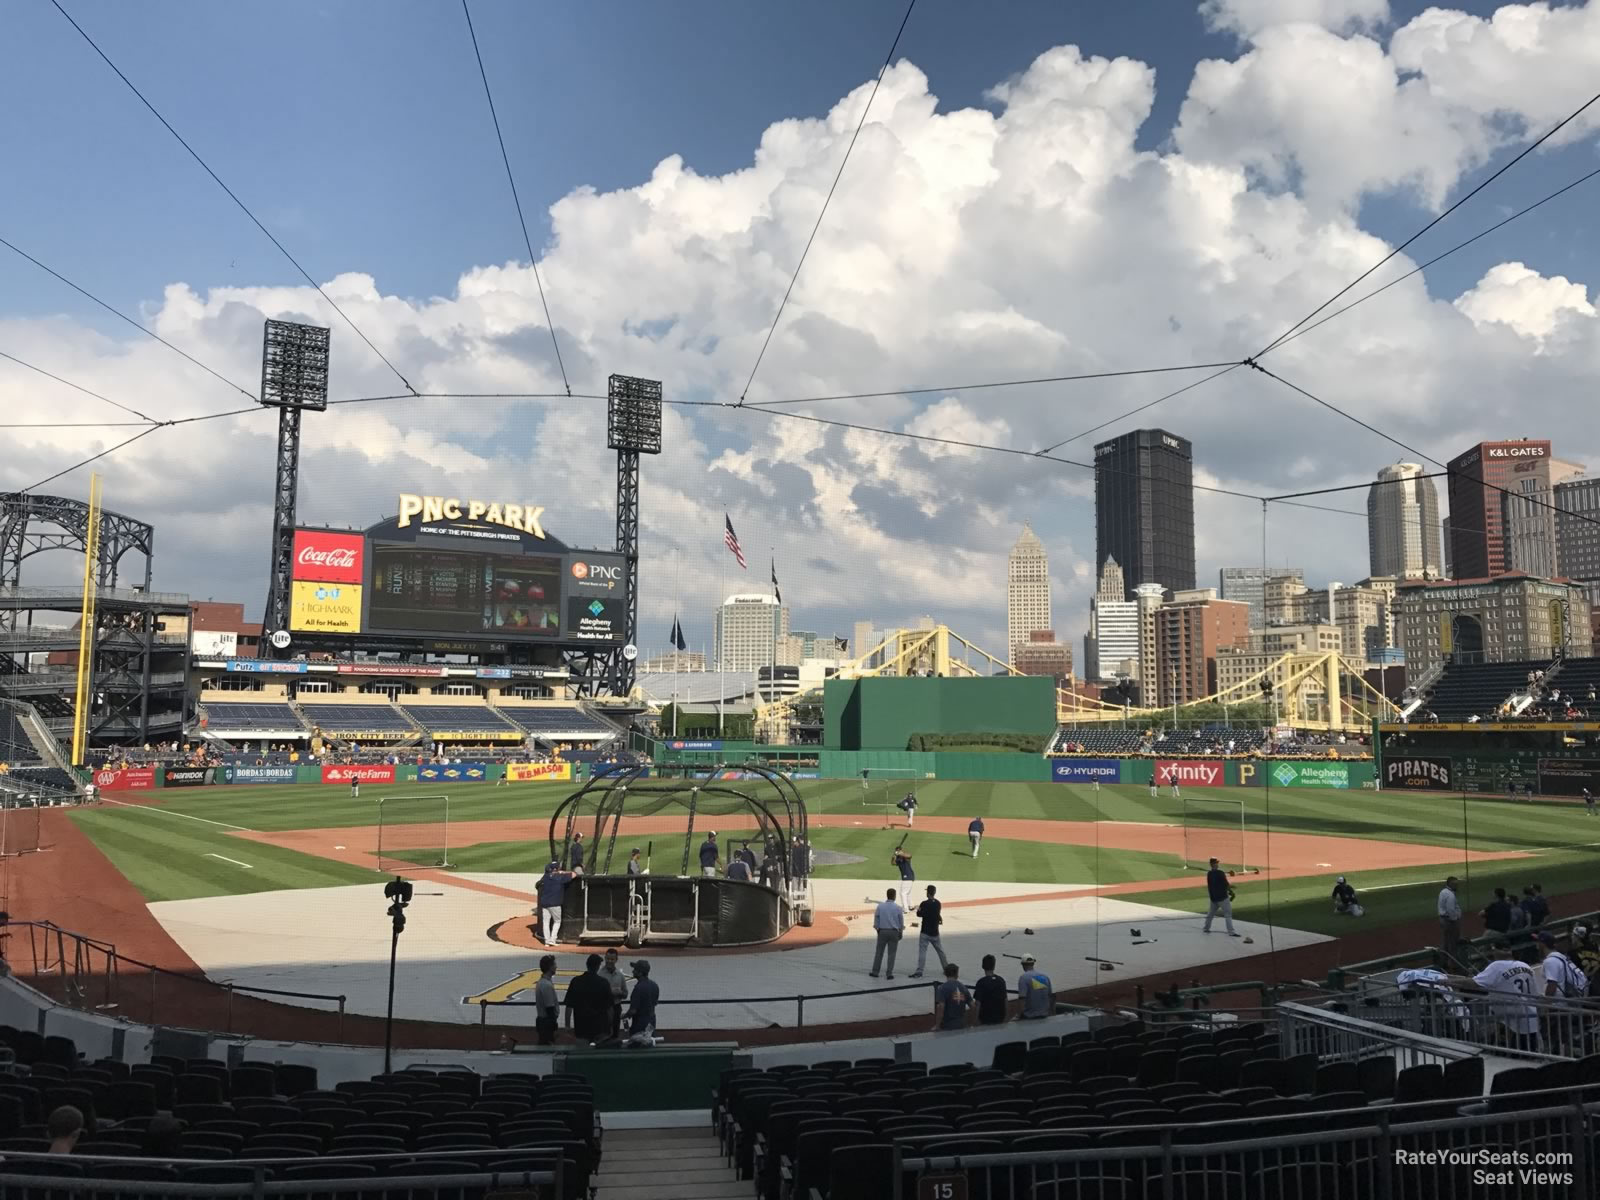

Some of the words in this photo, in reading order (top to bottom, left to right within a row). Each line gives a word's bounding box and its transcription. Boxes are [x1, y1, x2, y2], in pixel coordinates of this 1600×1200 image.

[1163, 435, 1180, 448] UPMC
[1490, 449, 1508, 457] K&L
[1510, 448, 1544, 456] GATES
[398, 493, 462, 528] PNC
[468, 500, 546, 540] PARK
[460, 530, 496, 538] PITTSBURGH
[299, 546, 358, 567] Coca-Cola
[590, 565, 621, 579] PNC
[580, 618, 611, 626] Allegheny
[220, 634, 234, 643] Lite
[274, 635, 289, 643] Lite
[1160, 763, 1218, 784] xfinity
[1240, 764, 1254, 784] P
[1301, 768, 1347, 778] Allegheny
[1388, 759, 1448, 784] PIRATES
[1405, 778, 1430, 786] .com
[1514, 978, 1531, 994] 31
[933, 1183, 952, 1199] 15
